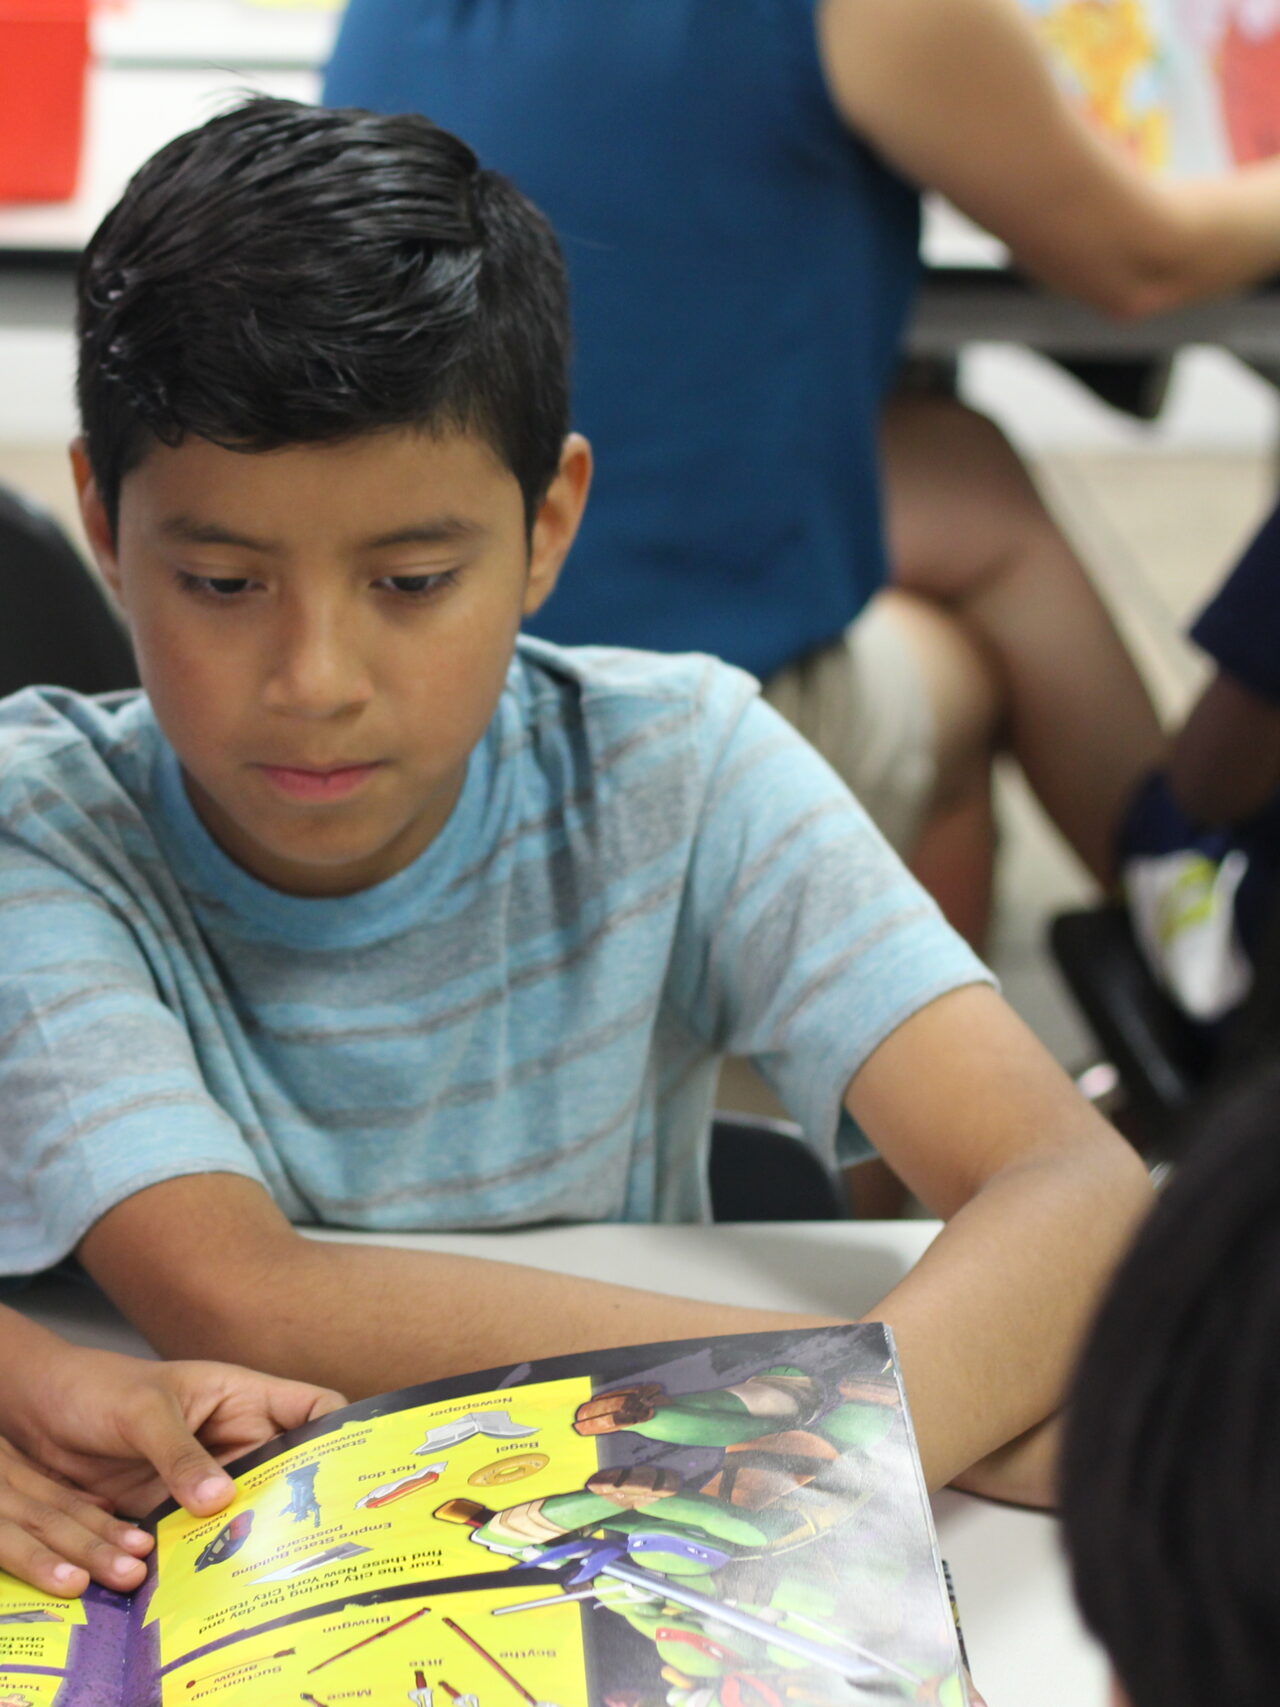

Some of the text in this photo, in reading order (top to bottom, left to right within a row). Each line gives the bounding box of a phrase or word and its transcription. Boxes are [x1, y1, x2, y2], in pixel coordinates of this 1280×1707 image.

[428, 1395, 513, 1418] Newspaper
[495, 1440, 539, 1454] Bagel
[243, 1427, 374, 1487] souvenir statuette
[248, 1437, 367, 1491] Statue of Liberty
[357, 1462, 417, 1483] Hot dog
[182, 1513, 227, 1539] helmet
[276, 1524, 344, 1552] postcard
[231, 1521, 392, 1579] Empire State Building
[411, 1550, 443, 1561] find
[361, 1554, 407, 1569] these
[324, 1566, 358, 1578] New
[286, 1575, 319, 1590] York
[198, 1560, 443, 1634] Tour the city during the day and
[252, 1588, 281, 1603] City
[322, 1615, 390, 1634] Blowgun
[409, 1659, 444, 1669] Jitte
[499, 1648, 557, 1661] Scythe
[191, 1666, 282, 1701] Suction-cup
[214, 1664, 258, 1684] arrow
[327, 1689, 372, 1701] Mace
